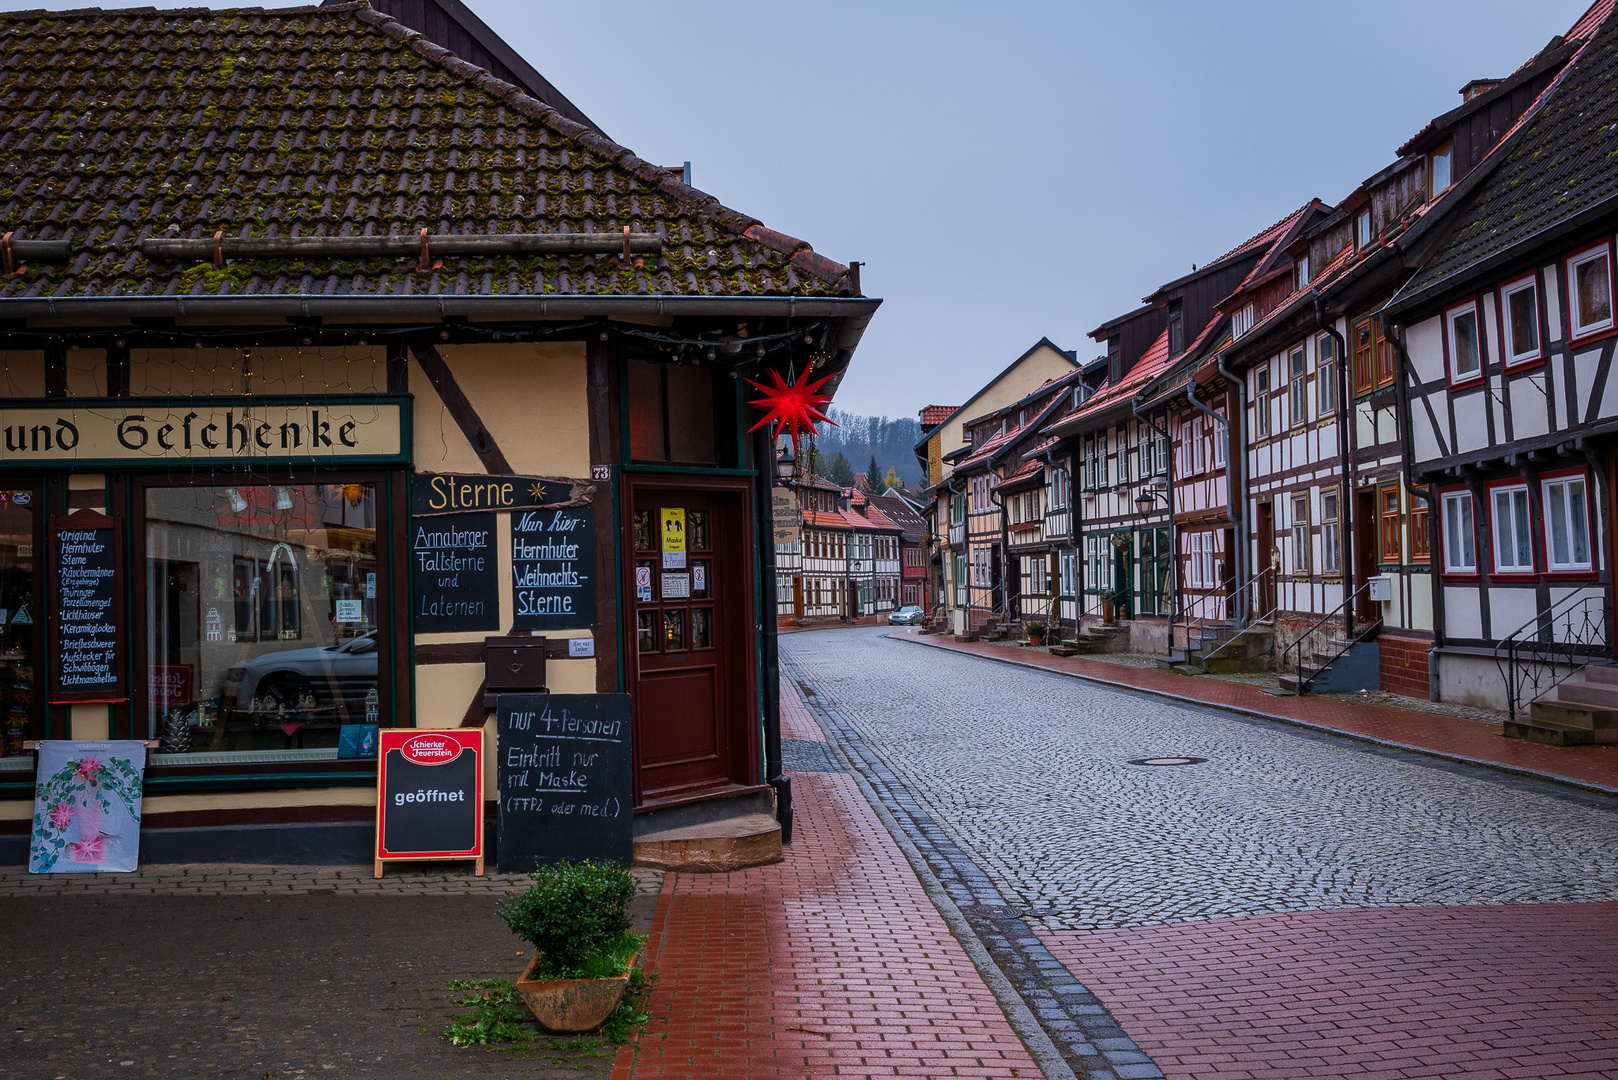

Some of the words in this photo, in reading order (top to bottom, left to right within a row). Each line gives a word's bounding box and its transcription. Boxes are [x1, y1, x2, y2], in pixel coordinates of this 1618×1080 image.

[4, 417, 79, 451] und
[593, 467, 608, 479] 73
[429, 476, 513, 509] Sterne
[216, 515, 314, 527] HERRNHUTER
[514, 512, 543, 532] Nun
[61, 529, 96, 544] Original
[414, 525, 488, 551] Annaberger
[61, 542, 105, 553] Herrnhuter
[513, 536, 579, 559] Herrnhuter
[62, 554, 87, 565] Sterne
[417, 552, 485, 573] Faltsterne
[62, 566, 115, 577] Räuchermänner
[61, 578, 99, 587] (Erzgebirge)
[438, 573, 459, 588] und
[62, 587, 95, 598] Thüringer
[63, 597, 111, 609] Porzellanengel
[421, 595, 484, 616] Laternen
[518, 590, 573, 613] Sterne
[62, 609, 104, 620] Lichthäuser
[63, 623, 116, 636] Keramikglocken
[63, 638, 115, 652] Briefbeschwerer
[62, 652, 103, 662] Aufstecker
[105, 650, 115, 663] für
[63, 661, 109, 674] Schwibbögen
[62, 672, 117, 685] Lichtmanschetten
[509, 712, 535, 731] nur
[562, 709, 621, 736] Personen
[410, 740, 445, 749] Schierker
[412, 748, 452, 757] Feuerstein
[507, 745, 560, 767] Eintritt
[573, 752, 598, 766] nur
[539, 770, 588, 788] Maske
[395, 789, 464, 806] geöffnet
[551, 802, 575, 814] oder
